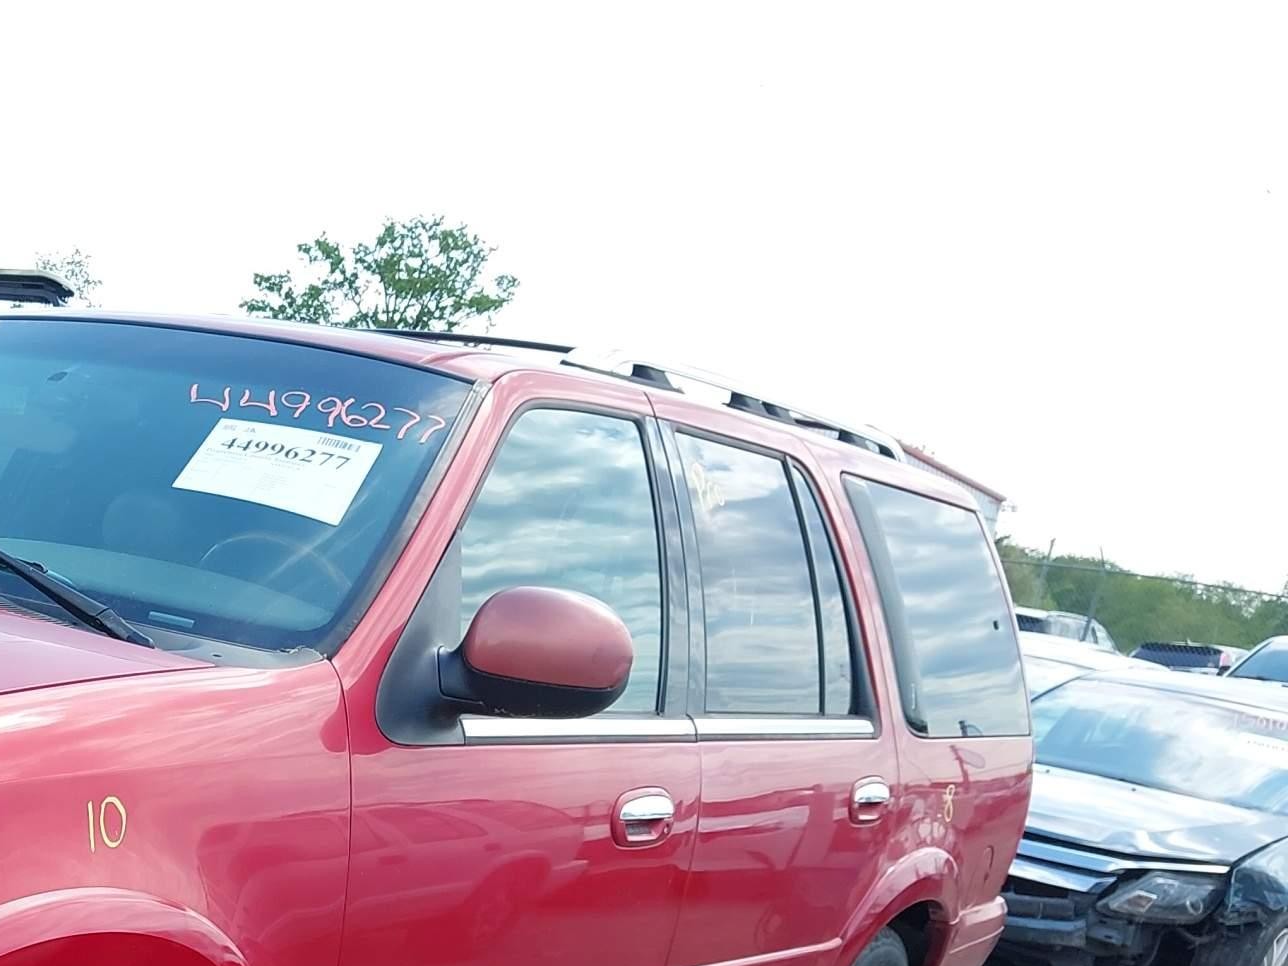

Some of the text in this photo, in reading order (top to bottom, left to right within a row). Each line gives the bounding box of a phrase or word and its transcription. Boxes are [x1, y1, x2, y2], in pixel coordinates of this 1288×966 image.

[189, 383, 447, 443] 44996277
[220, 437, 351, 470] 44996277
[87, 795, 127, 853] 10
